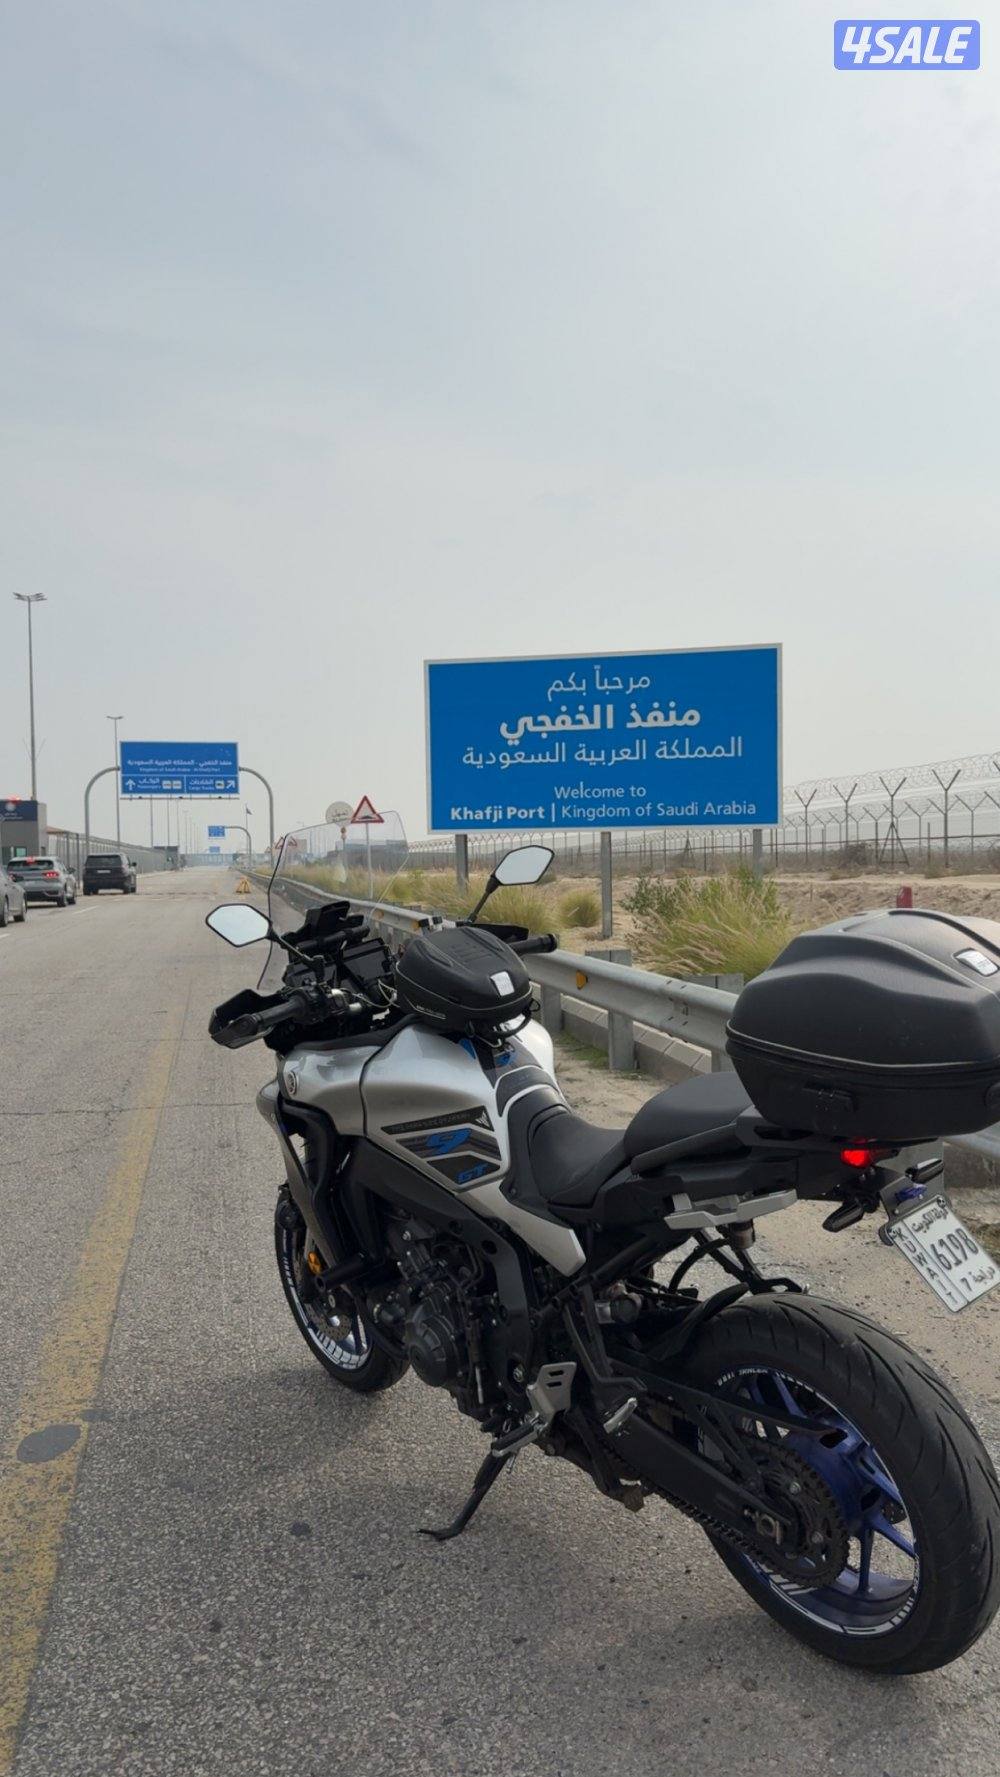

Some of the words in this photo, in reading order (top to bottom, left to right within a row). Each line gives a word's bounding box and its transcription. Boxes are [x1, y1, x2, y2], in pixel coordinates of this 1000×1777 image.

[547, 672, 587, 702] بكم
[595, 665, 651, 693] مرحباً
[500, 704, 614, 746] الخفجي
[626, 701, 701, 728] منفذ
[462, 742, 567, 769] السعودية
[574, 739, 647, 766] العربية
[655, 736, 743, 761] المملكة
[554, 781, 625, 800] Welcome
[630, 785, 647, 798] to
[450, 805, 503, 823] Khafji
[506, 806, 545, 820] Port
[561, 804, 630, 823] Kingdom
[635, 803, 653, 817] of
[656, 802, 699, 817] Saudi
[704, 800, 757, 816] Arabia
[930, 1227, 979, 1271] 6198
